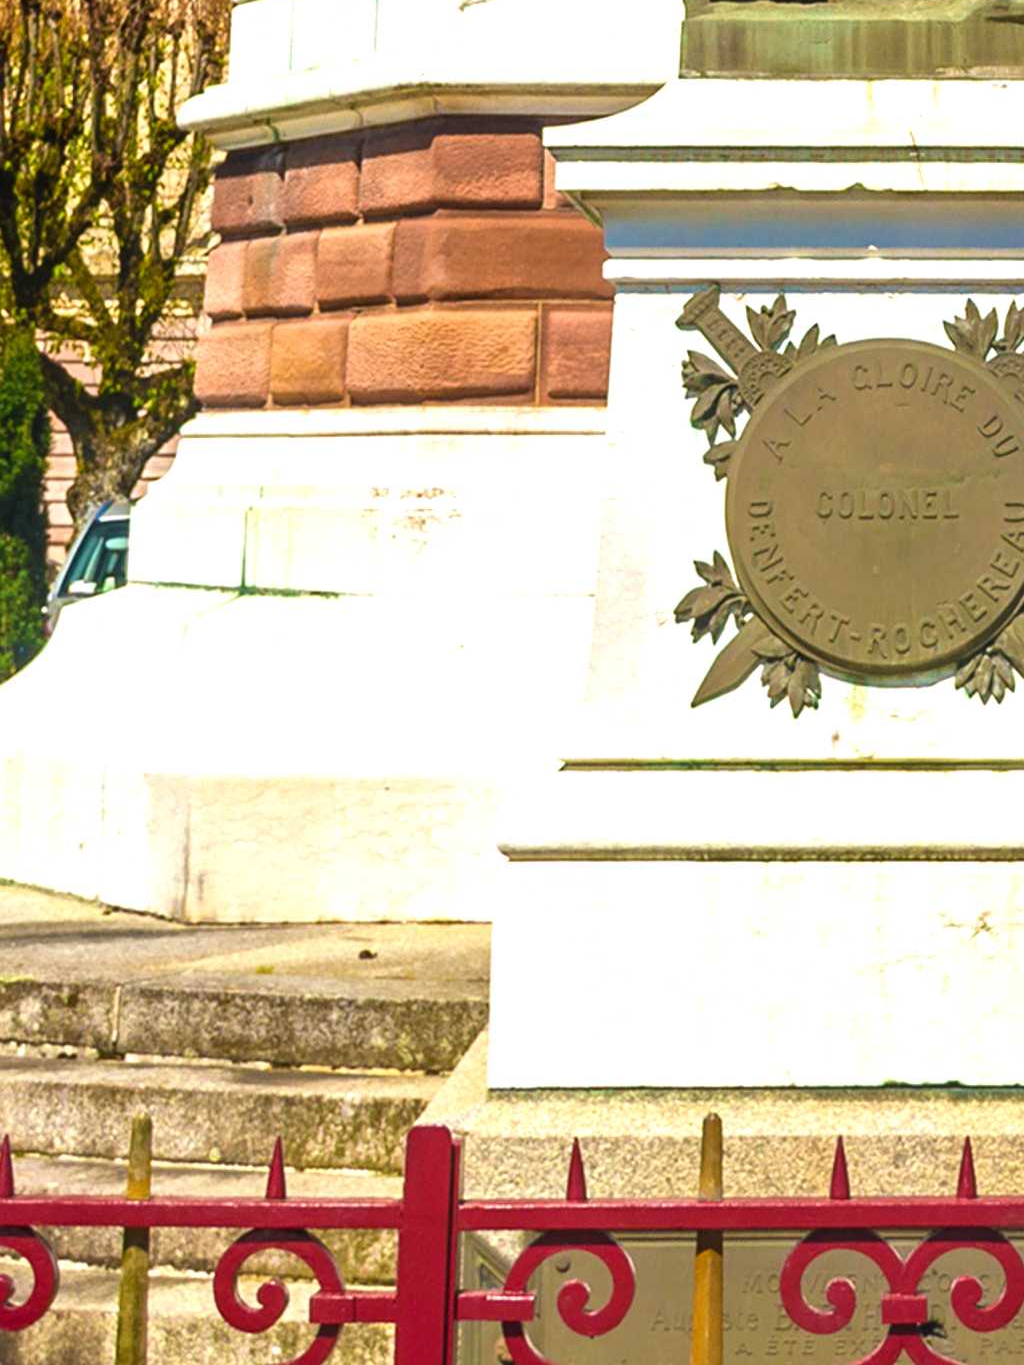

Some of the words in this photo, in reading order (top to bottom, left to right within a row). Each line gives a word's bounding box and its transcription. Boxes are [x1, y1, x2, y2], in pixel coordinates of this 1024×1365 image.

[762, 436, 790, 464] A
[784, 387, 836, 428] LA
[848, 362, 976, 413] GLOIRE
[976, 414, 1020, 460] DU
[814, 489, 960, 521] COLONEL
